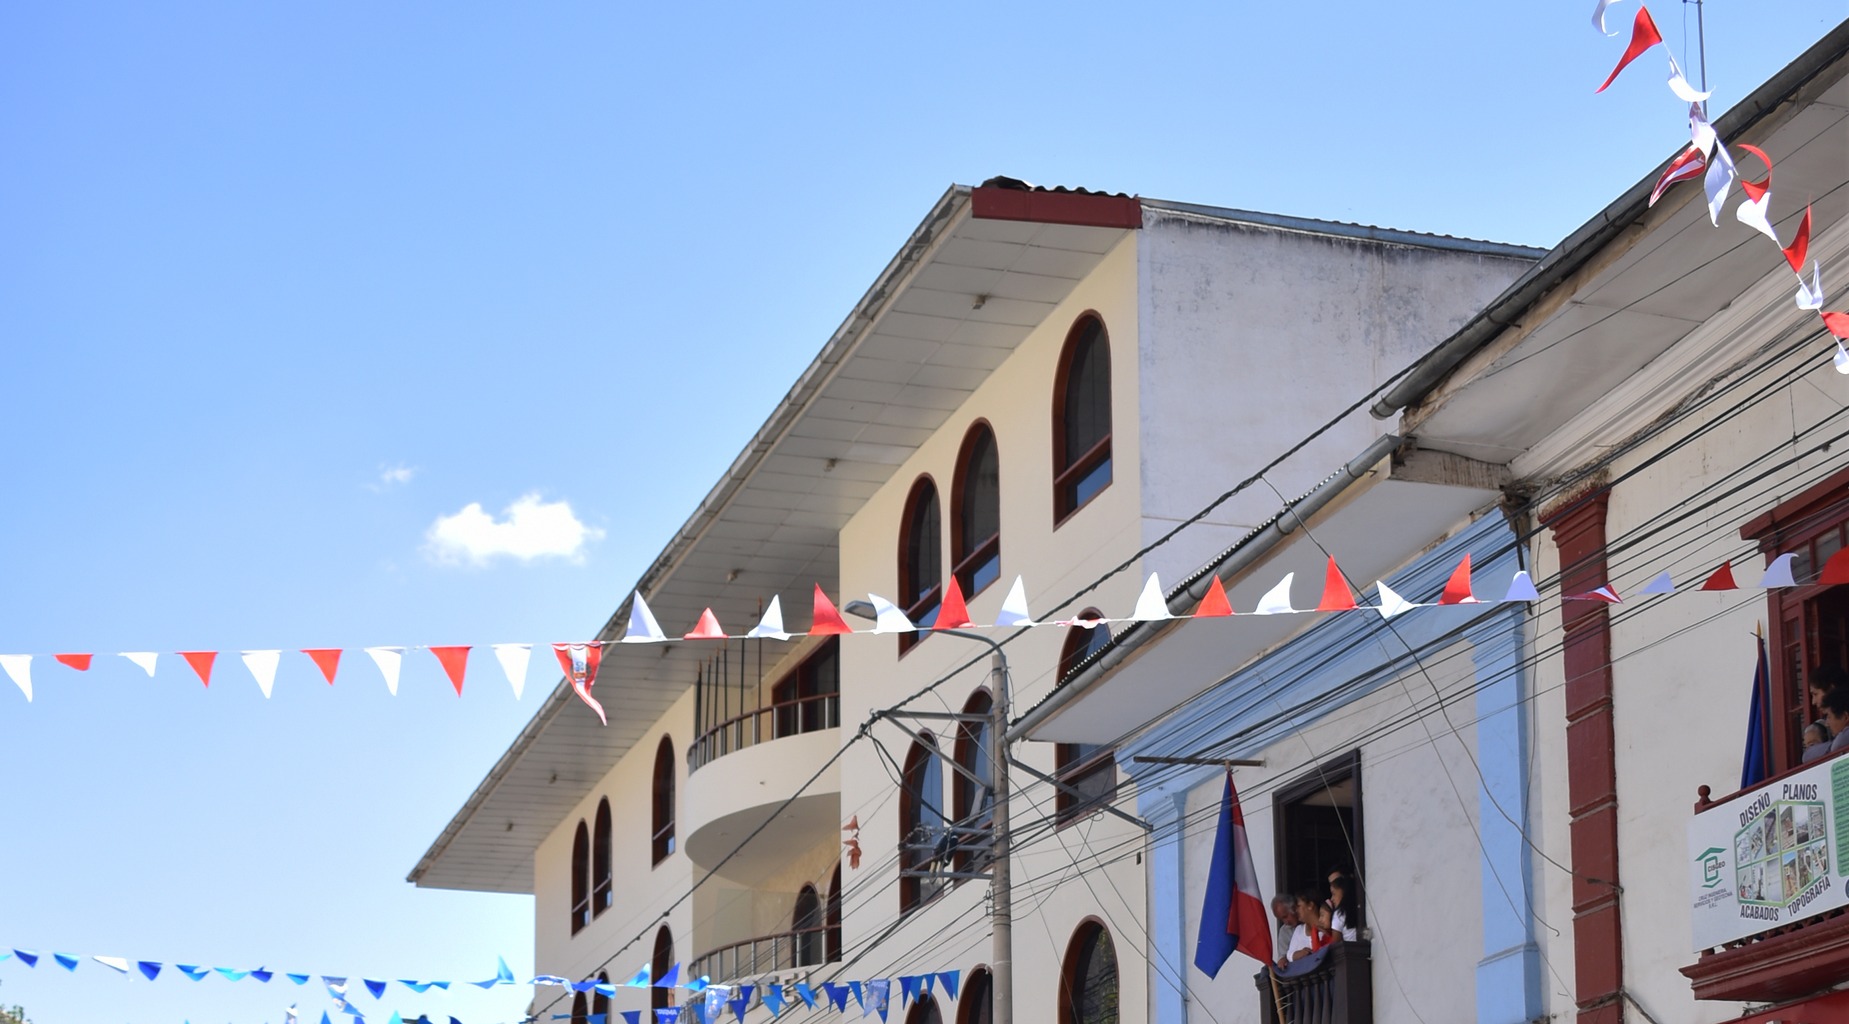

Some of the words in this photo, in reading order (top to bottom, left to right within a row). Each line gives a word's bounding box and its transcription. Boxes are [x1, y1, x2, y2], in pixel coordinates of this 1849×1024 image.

[1740, 793, 1771, 828] DISEÑO
[1782, 783, 1817, 801] PLANOS
[1740, 904, 1779, 921] ACABADOS
